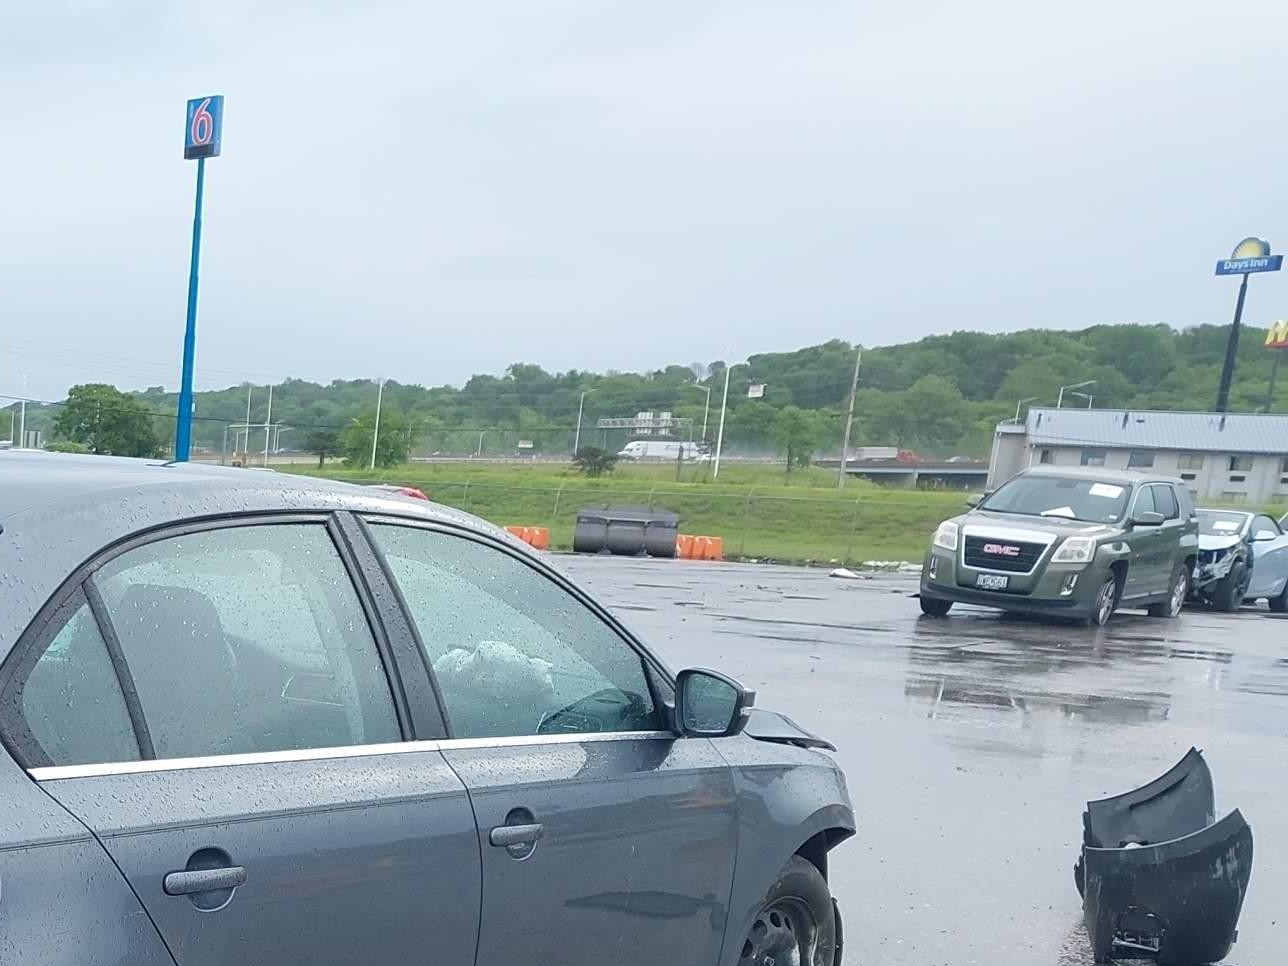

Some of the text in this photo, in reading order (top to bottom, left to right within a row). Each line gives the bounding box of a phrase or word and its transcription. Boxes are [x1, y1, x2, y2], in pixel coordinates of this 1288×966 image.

[191, 98, 214, 145] 6
[1223, 258, 1269, 270] Days Inn
[983, 543, 1021, 556] GMC
